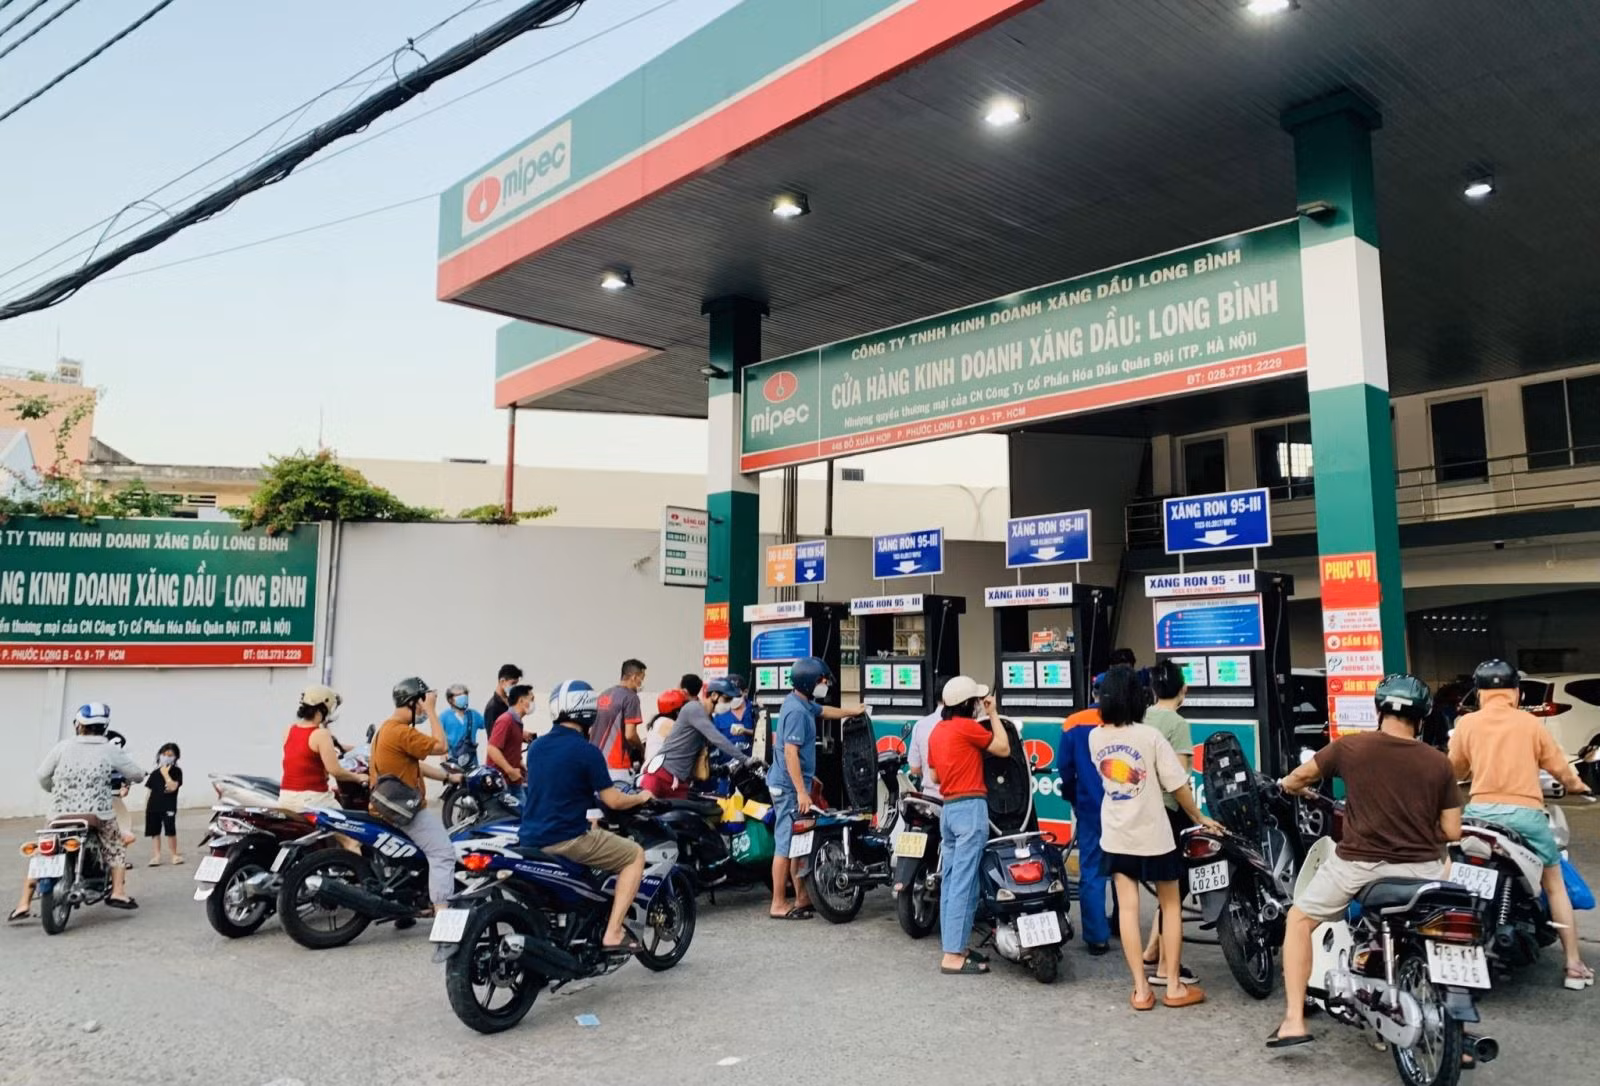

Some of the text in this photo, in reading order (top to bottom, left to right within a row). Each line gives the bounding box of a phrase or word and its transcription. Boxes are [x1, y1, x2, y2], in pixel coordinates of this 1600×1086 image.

[502, 142, 566, 206] mipec
[852, 342, 885, 360] CÔNG
[889, 336, 905, 351] TY
[909, 326, 946, 346] TNHH
[951, 316, 985, 336] KINH
[990, 301, 1042, 326] DOANH
[1046, 288, 1092, 311] XĂNG
[1139, 263, 1188, 289] LONG
[1194, 249, 1241, 275] BÌNH
[831, 279, 1279, 410] CỬA HÀNG KINH DOANH XĂNG DẦU: LONG BÌNH
[970, 391, 983, 403] CN
[1012, 380, 1024, 395] Ty
[1154, 349, 1174, 366] Đội
[1178, 343, 1203, 362] (TP.
[1206, 336, 1224, 355] HÀ
[751, 404, 809, 438] mipec
[1171, 496, 1262, 520] XĂNG RON 95-III
[1038, 520, 1057, 535] RON
[1059, 517, 1084, 532] 95-III
[6, 530, 24, 546] TY
[28, 531, 65, 547] TNHH
[69, 532, 102, 548] KINH
[105, 533, 150, 549] DOANH
[154, 532, 189, 550] XĂNG
[223, 535, 255, 550] LONG
[900, 536, 915, 550] RON
[1184, 576, 1208, 586] RON
[1212, 575, 1226, 585] 95
[1238, 573, 1250, 584] III
[1325, 559, 1371, 584] PHỤC VỤ
[28, 571, 70, 605] KINH
[74, 572, 131, 606] DOANH
[134, 567, 179, 607] XĂNG
[182, 560, 217, 607] DẦU
[224, 574, 266, 608] LONG
[269, 567, 308, 608] BÌNH
[1016, 588, 1034, 598] RON
[1038, 587, 1049, 597] 95
[876, 598, 892, 608] RON
[894, 598, 904, 607] 95
[80, 619, 93, 634] CN
[118, 620, 129, 636] Ty
[226, 620, 240, 637] Đội
[260, 616, 272, 635] HÀ
[40, 649, 61, 660] LONG
[108, 649, 125, 660] HCM
